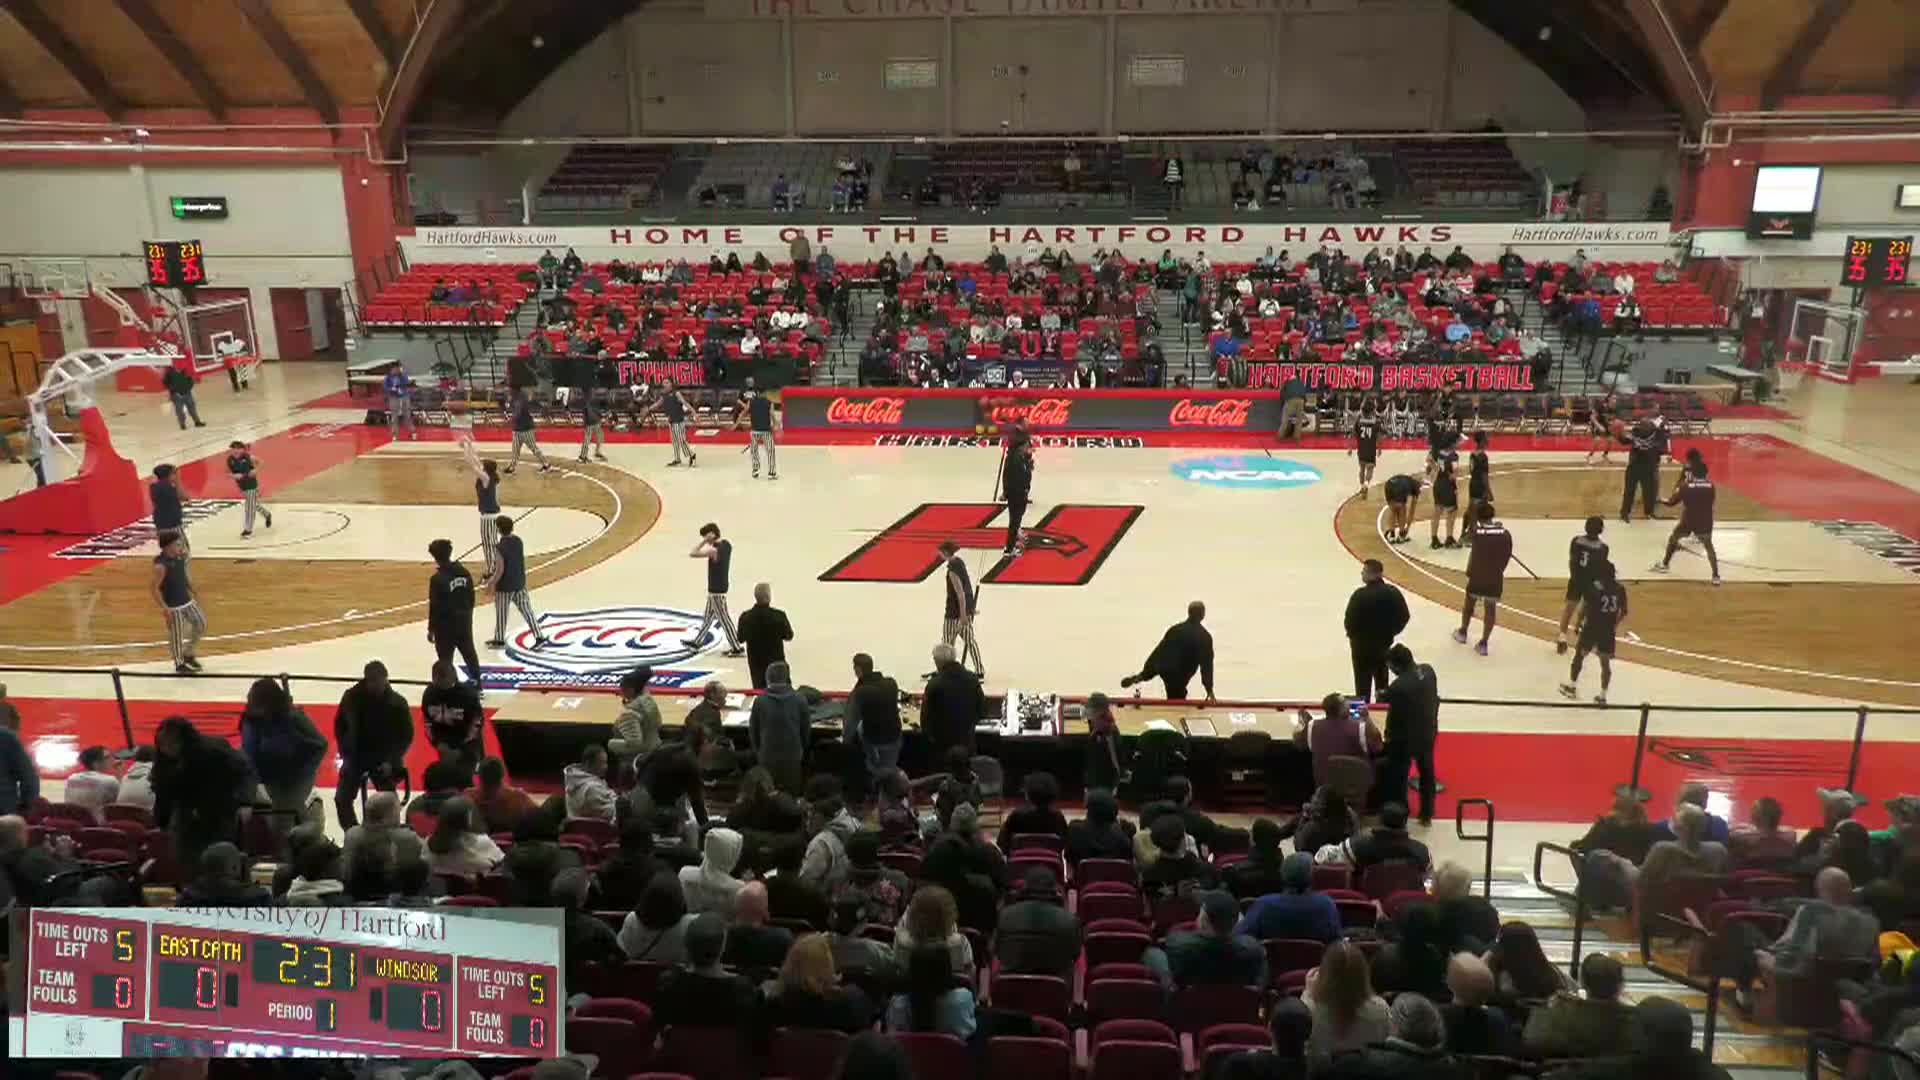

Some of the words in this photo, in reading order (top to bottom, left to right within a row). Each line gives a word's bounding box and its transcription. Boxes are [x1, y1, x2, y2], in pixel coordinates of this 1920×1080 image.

[426, 230, 557, 246] HartfordHawks.com
[610, 228, 743, 244] HOME
[779, 227, 834, 243] OF
[863, 227, 950, 243] THE
[990, 226, 1246, 243] HARTFORD
[1283, 226, 1452, 243] HAWKS
[1511, 227, 1658, 242] HartfordHawks.com
[1247, 364, 1375, 390] HARTFORD
[1381, 365, 1535, 391] BASKETBALL
[827, 397, 906, 425] Coca-Cola
[1169, 399, 1253, 427] Coca-Cola
[1186, 468, 1322, 481] NCAA
